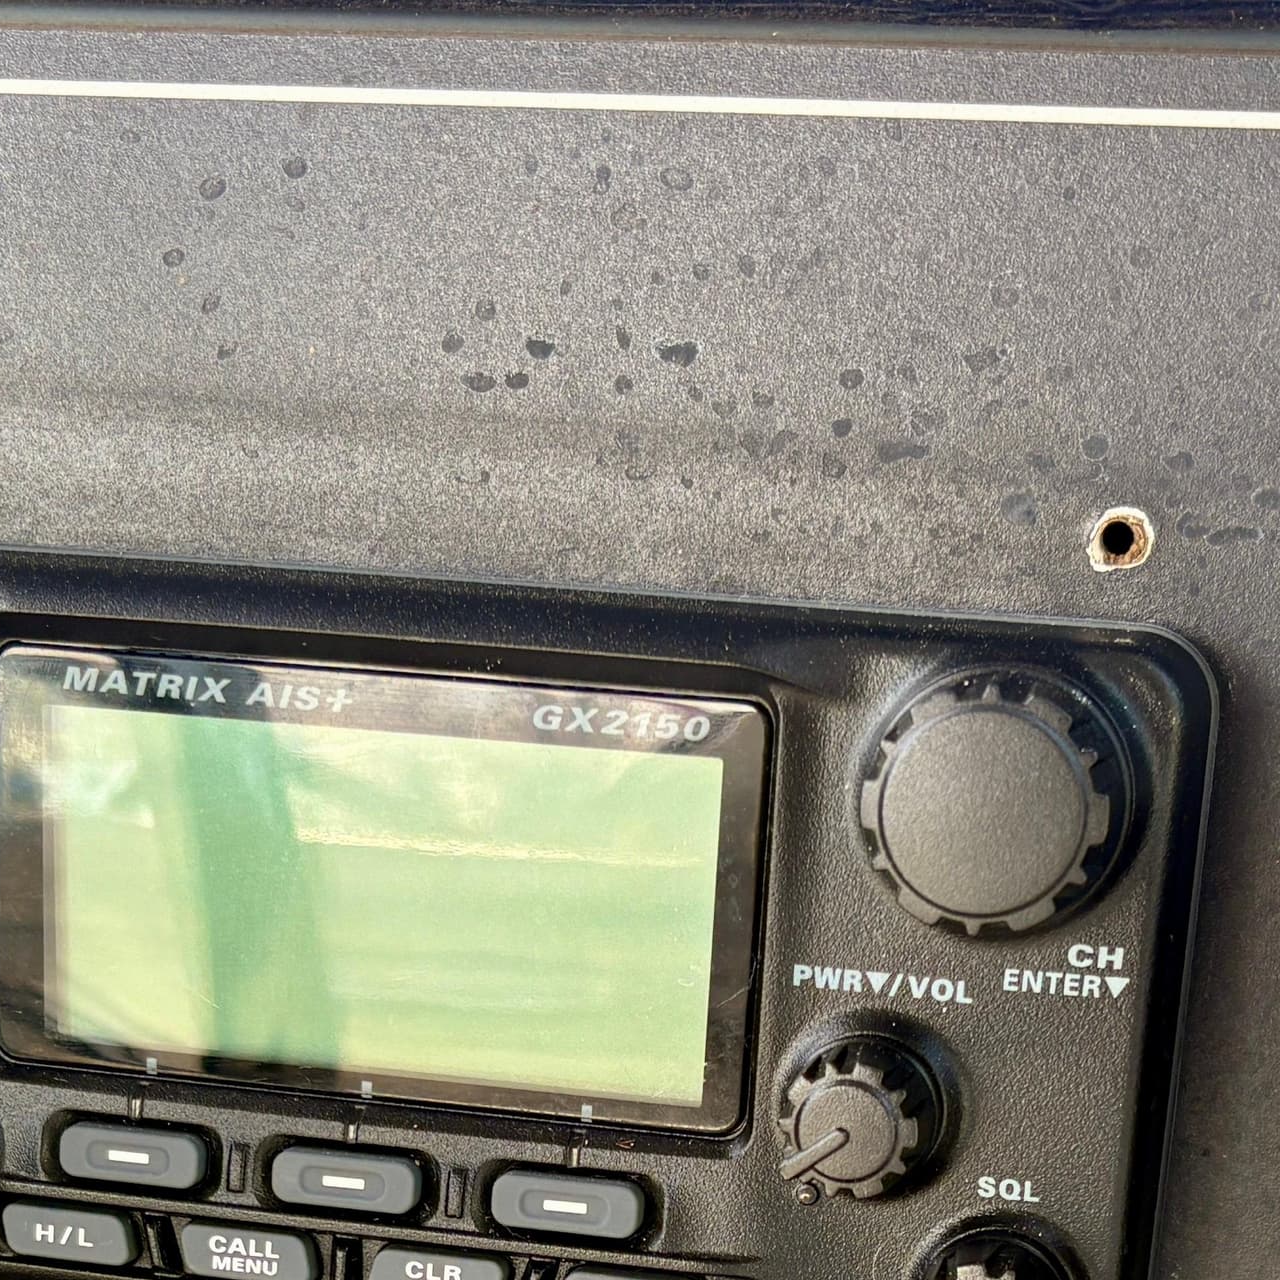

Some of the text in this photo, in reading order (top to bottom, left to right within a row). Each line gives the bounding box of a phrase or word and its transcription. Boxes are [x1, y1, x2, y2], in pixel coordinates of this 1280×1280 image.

[63, 666, 354, 713] MATRIX AIS+
[532, 705, 711, 742] GX2150
[1067, 943, 1125, 970] CH
[1002, 968, 1101, 998] ENTER
[977, 1176, 1040, 1202] SQL
[208, 1235, 280, 1259] CALL
[211, 1255, 278, 1277] MENU
